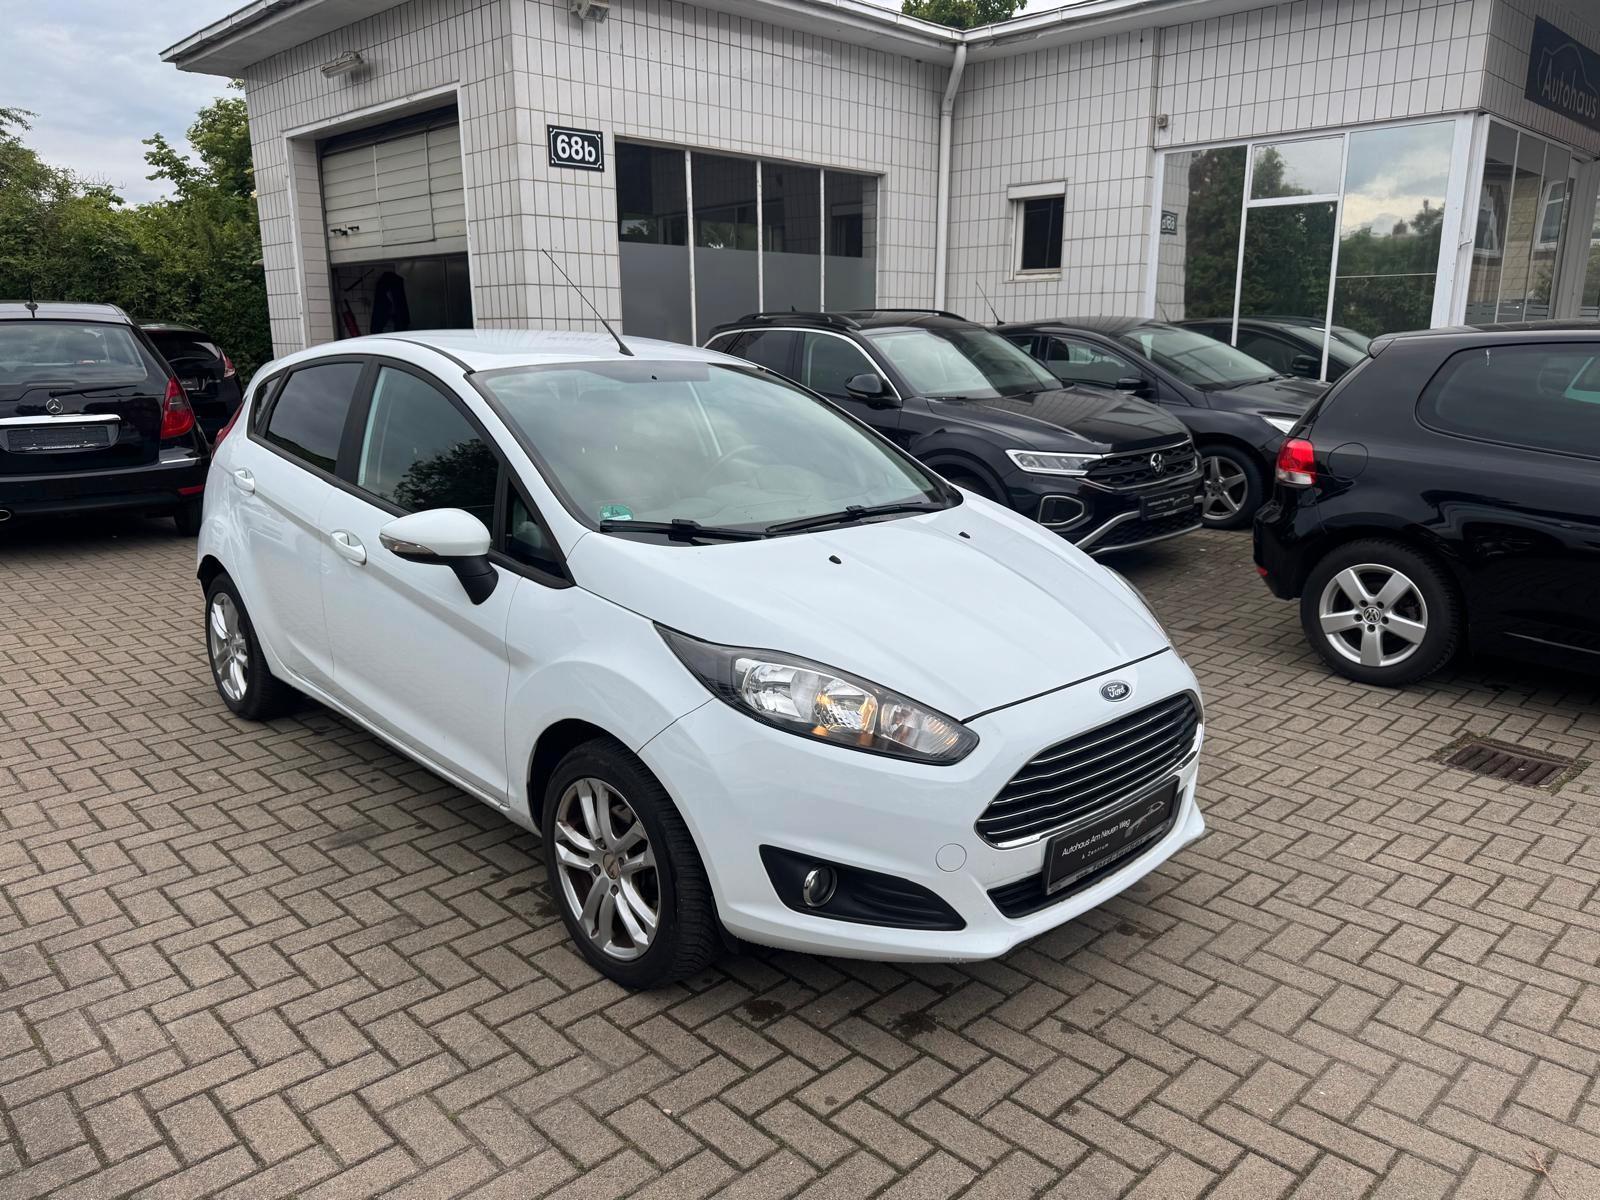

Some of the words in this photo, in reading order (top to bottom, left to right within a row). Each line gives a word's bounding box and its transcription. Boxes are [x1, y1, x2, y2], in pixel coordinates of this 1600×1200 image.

[1542, 57, 1598, 120] Autohaus
[556, 134, 596, 162] 68b
[1107, 684, 1127, 698] Ford
[1061, 838, 1091, 857] Autohaus
[1090, 834, 1101, 844] Am
[1101, 825, 1119, 839] Neuen
